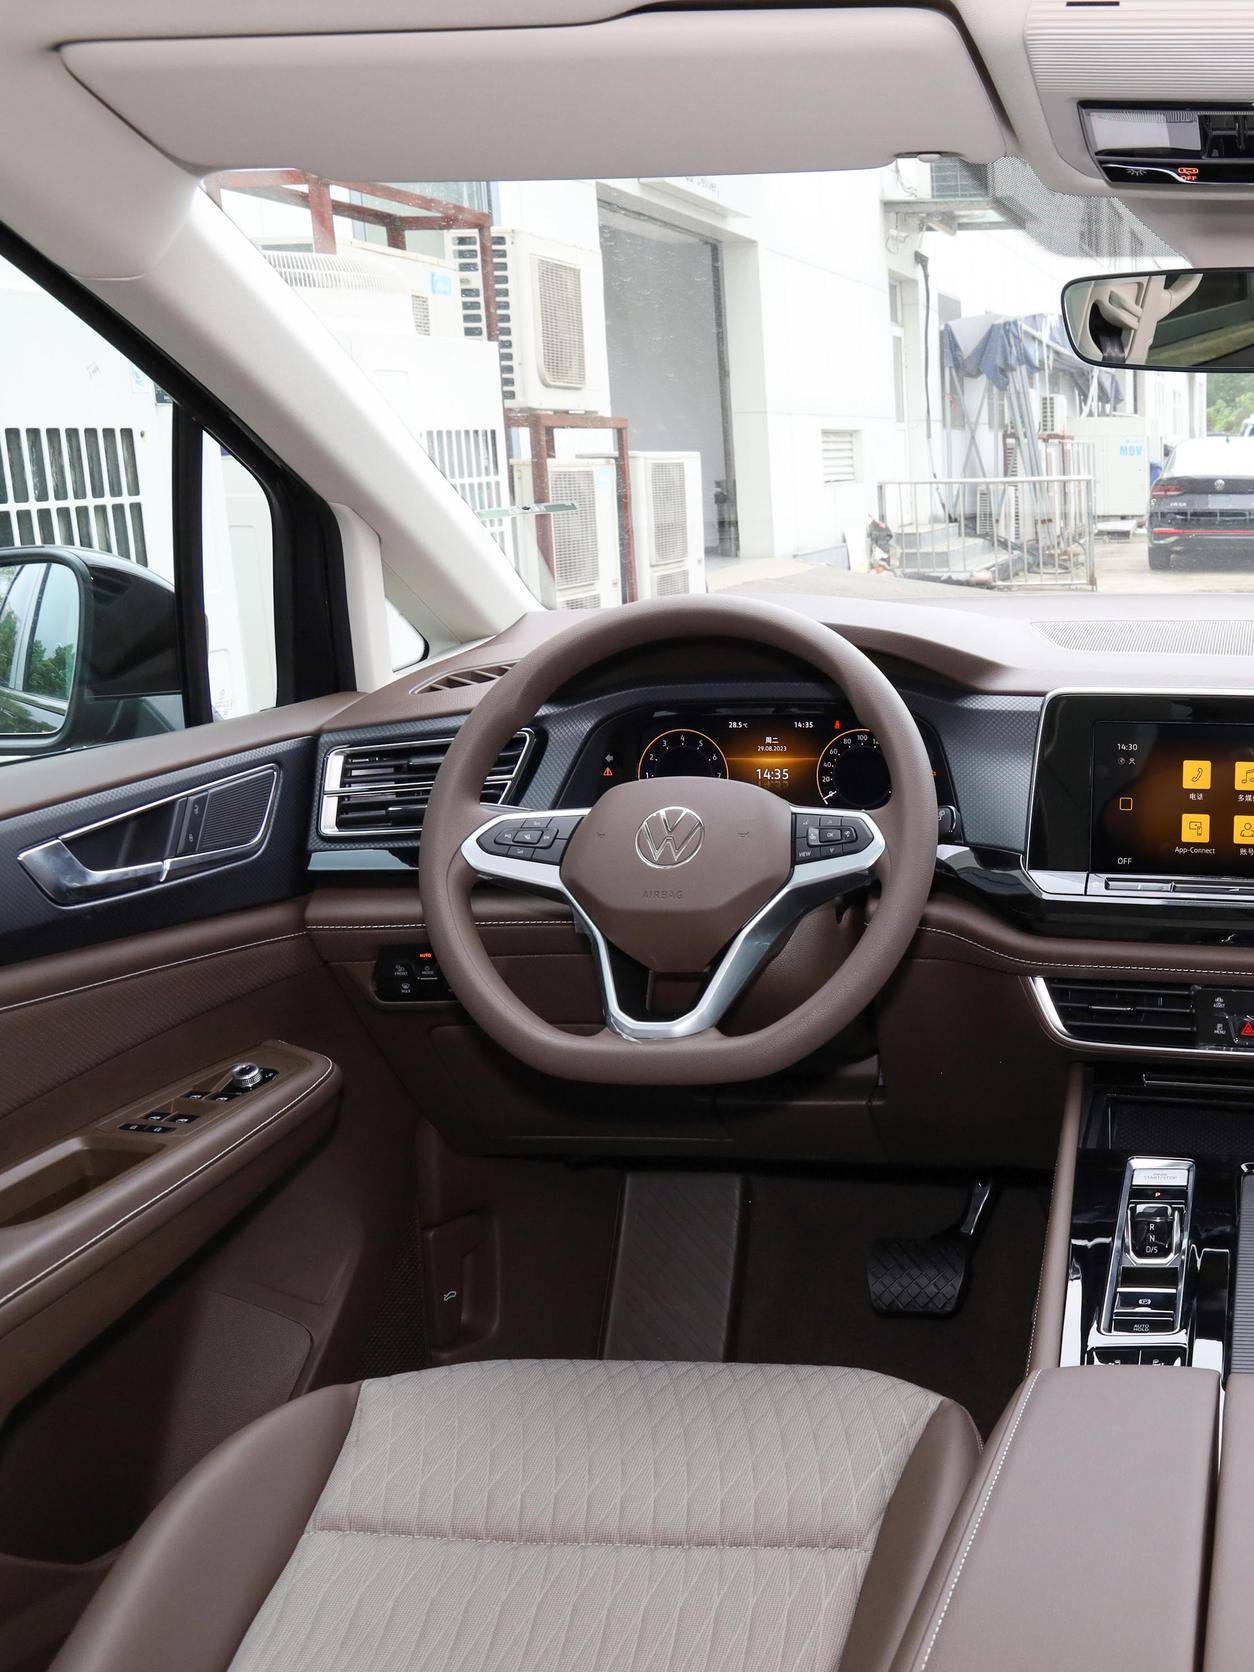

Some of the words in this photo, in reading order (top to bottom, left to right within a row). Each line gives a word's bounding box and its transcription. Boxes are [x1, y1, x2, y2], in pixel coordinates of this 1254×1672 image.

[794, 721, 813, 729] 14:35
[662, 739, 667, 747] 3
[698, 739, 703, 747] 5
[765, 736, 779, 744] 周二
[1117, 743, 1138, 751] 14:30
[649, 753, 654, 761] 2
[756, 769, 789, 780] 14:35
[1174, 846, 1215, 855] App-Connect
[1239, 848, 1254, 856] 账号
[1117, 857, 1132, 865] OFF
[642, 890, 684, 899] AIRBAG
[1149, 1223, 1155, 1231] R
[1149, 1234, 1155, 1242] N
[1145, 1246, 1158, 1254] D/S
